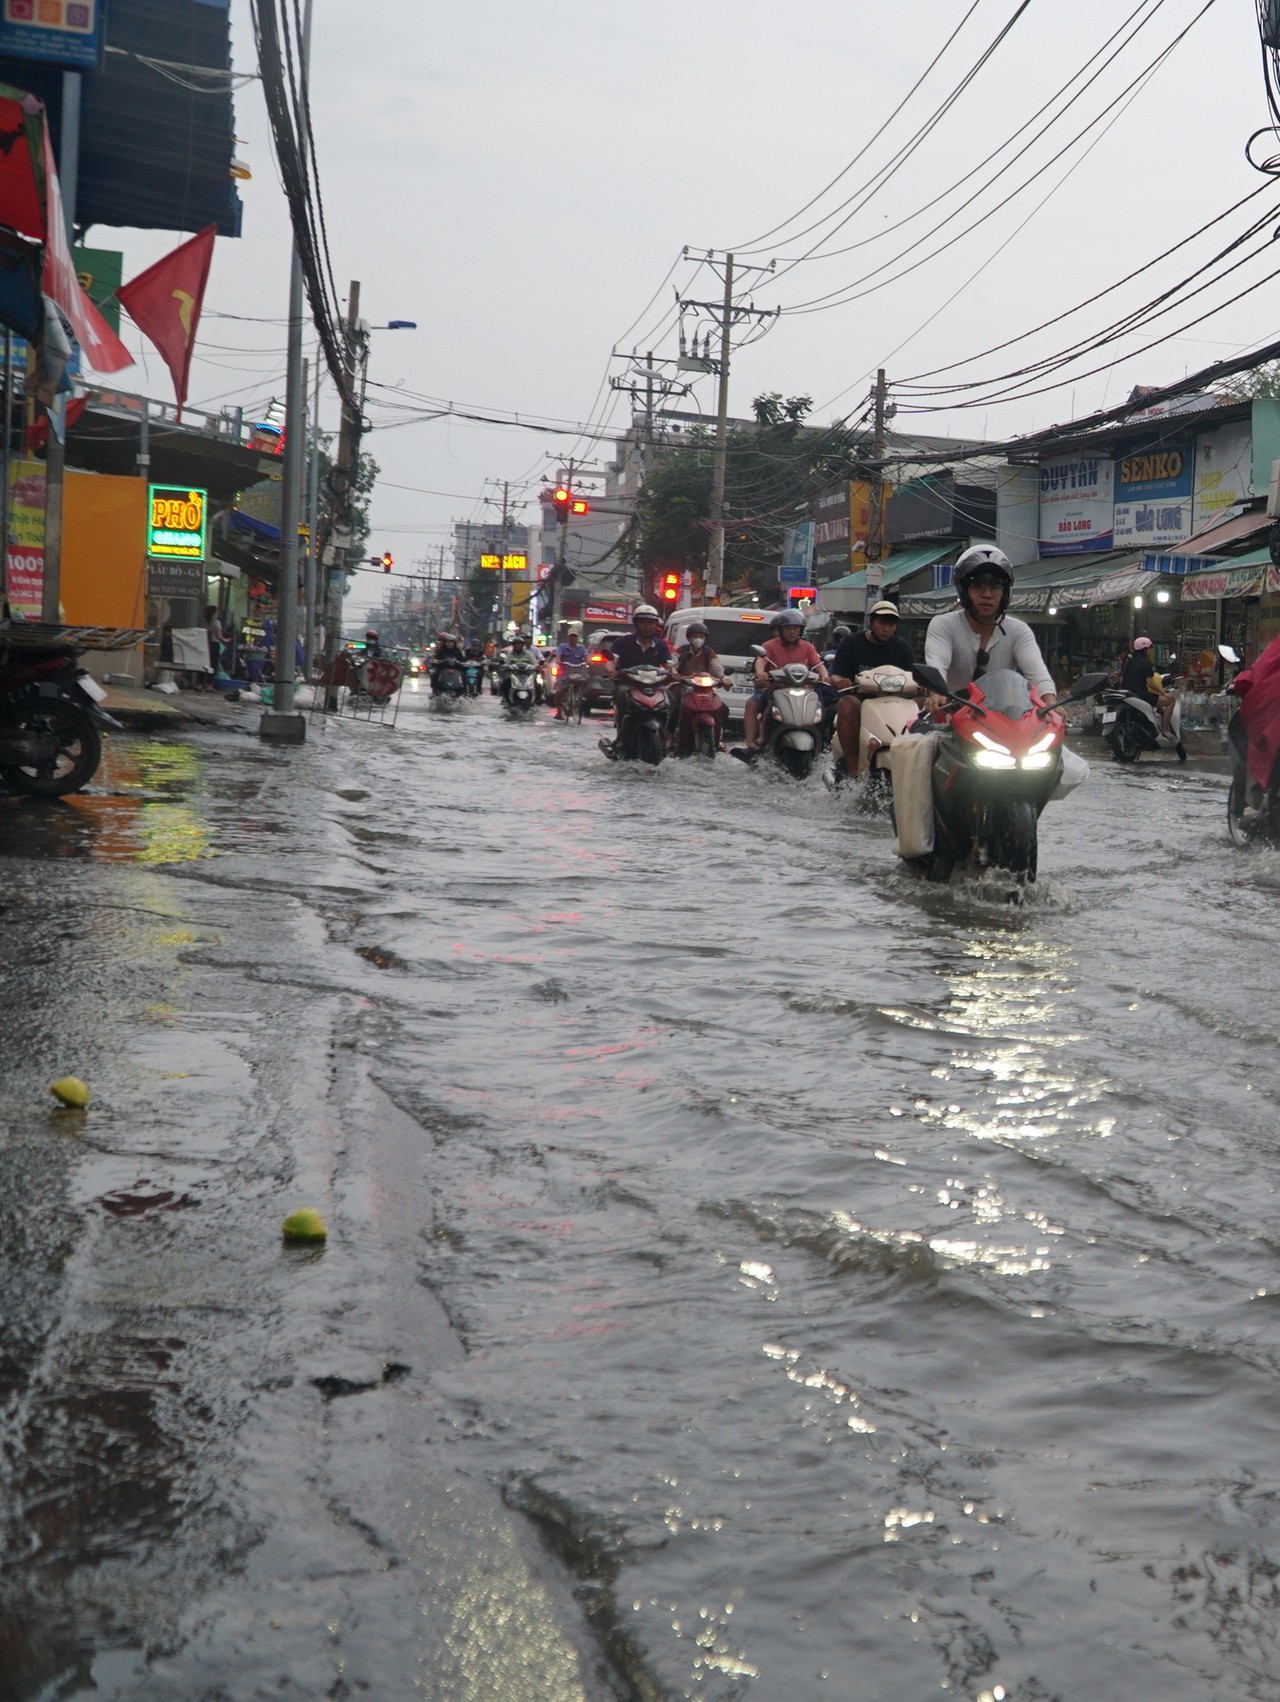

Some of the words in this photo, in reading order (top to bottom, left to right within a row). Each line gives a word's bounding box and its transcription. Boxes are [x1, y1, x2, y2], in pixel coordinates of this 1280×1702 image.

[1121, 451, 1183, 484] SENKO
[152, 491, 202, 531] PHỞ
[1156, 506, 1182, 531] LONG
[1073, 520, 1092, 531] LONG
[169, 565, 182, 577] BÒ
[587, 607, 614, 616] CIRCLE
